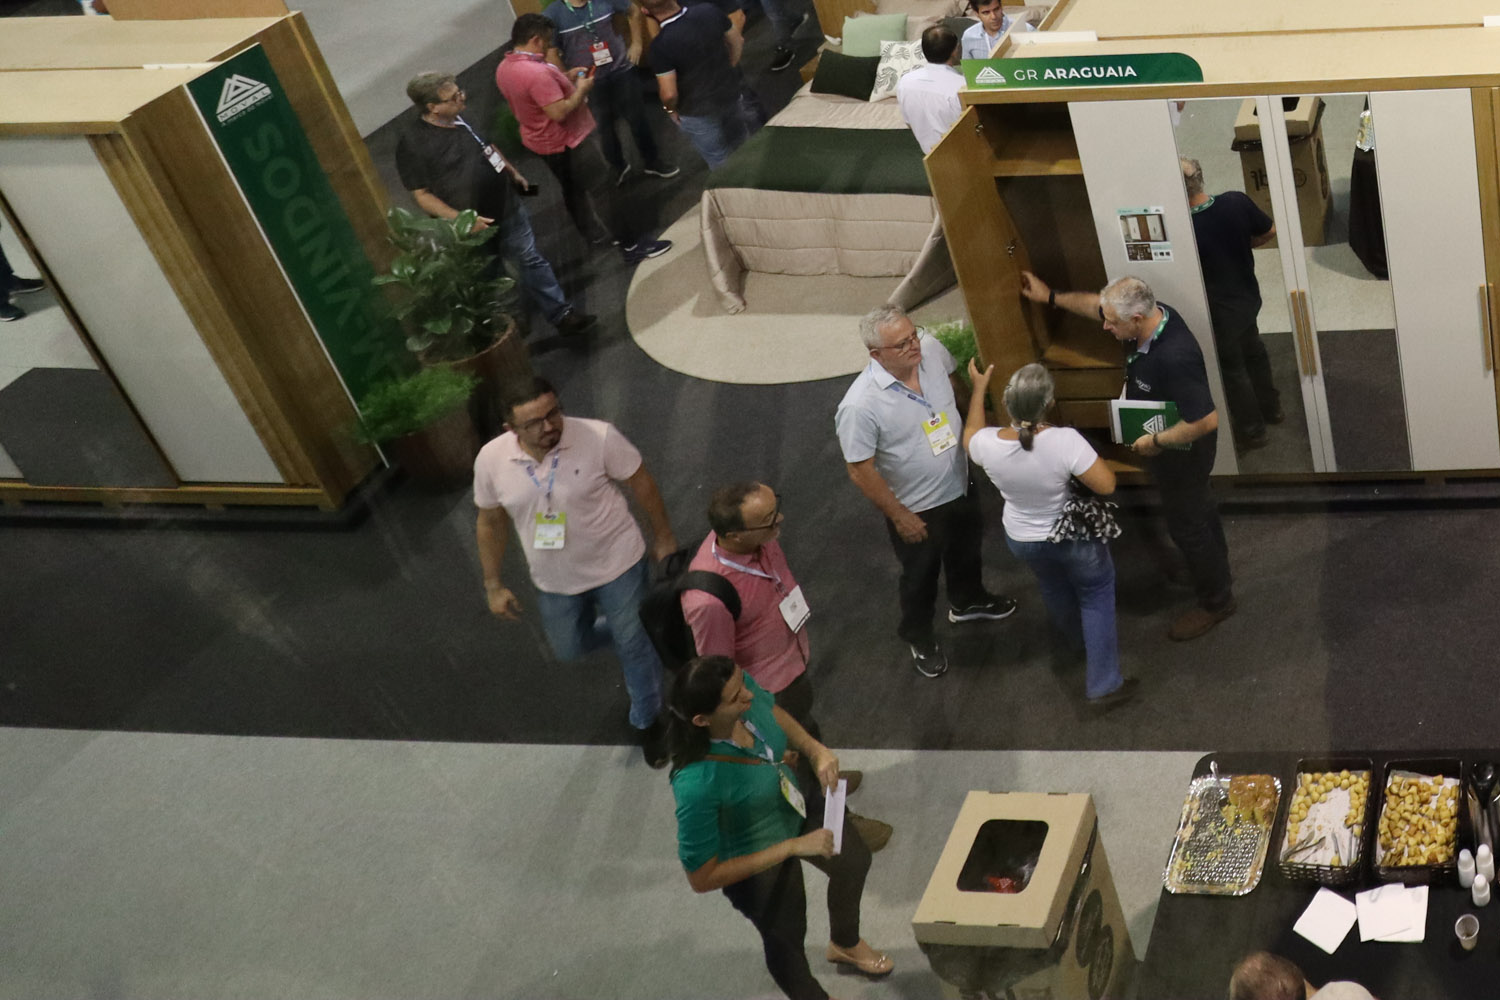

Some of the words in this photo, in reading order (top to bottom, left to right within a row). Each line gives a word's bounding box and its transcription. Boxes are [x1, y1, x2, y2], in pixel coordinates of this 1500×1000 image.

[1013, 69, 1038, 81] GR
[1043, 65, 1138, 80] ARAGUAIA
[217, 86, 272, 123] MOVAL
